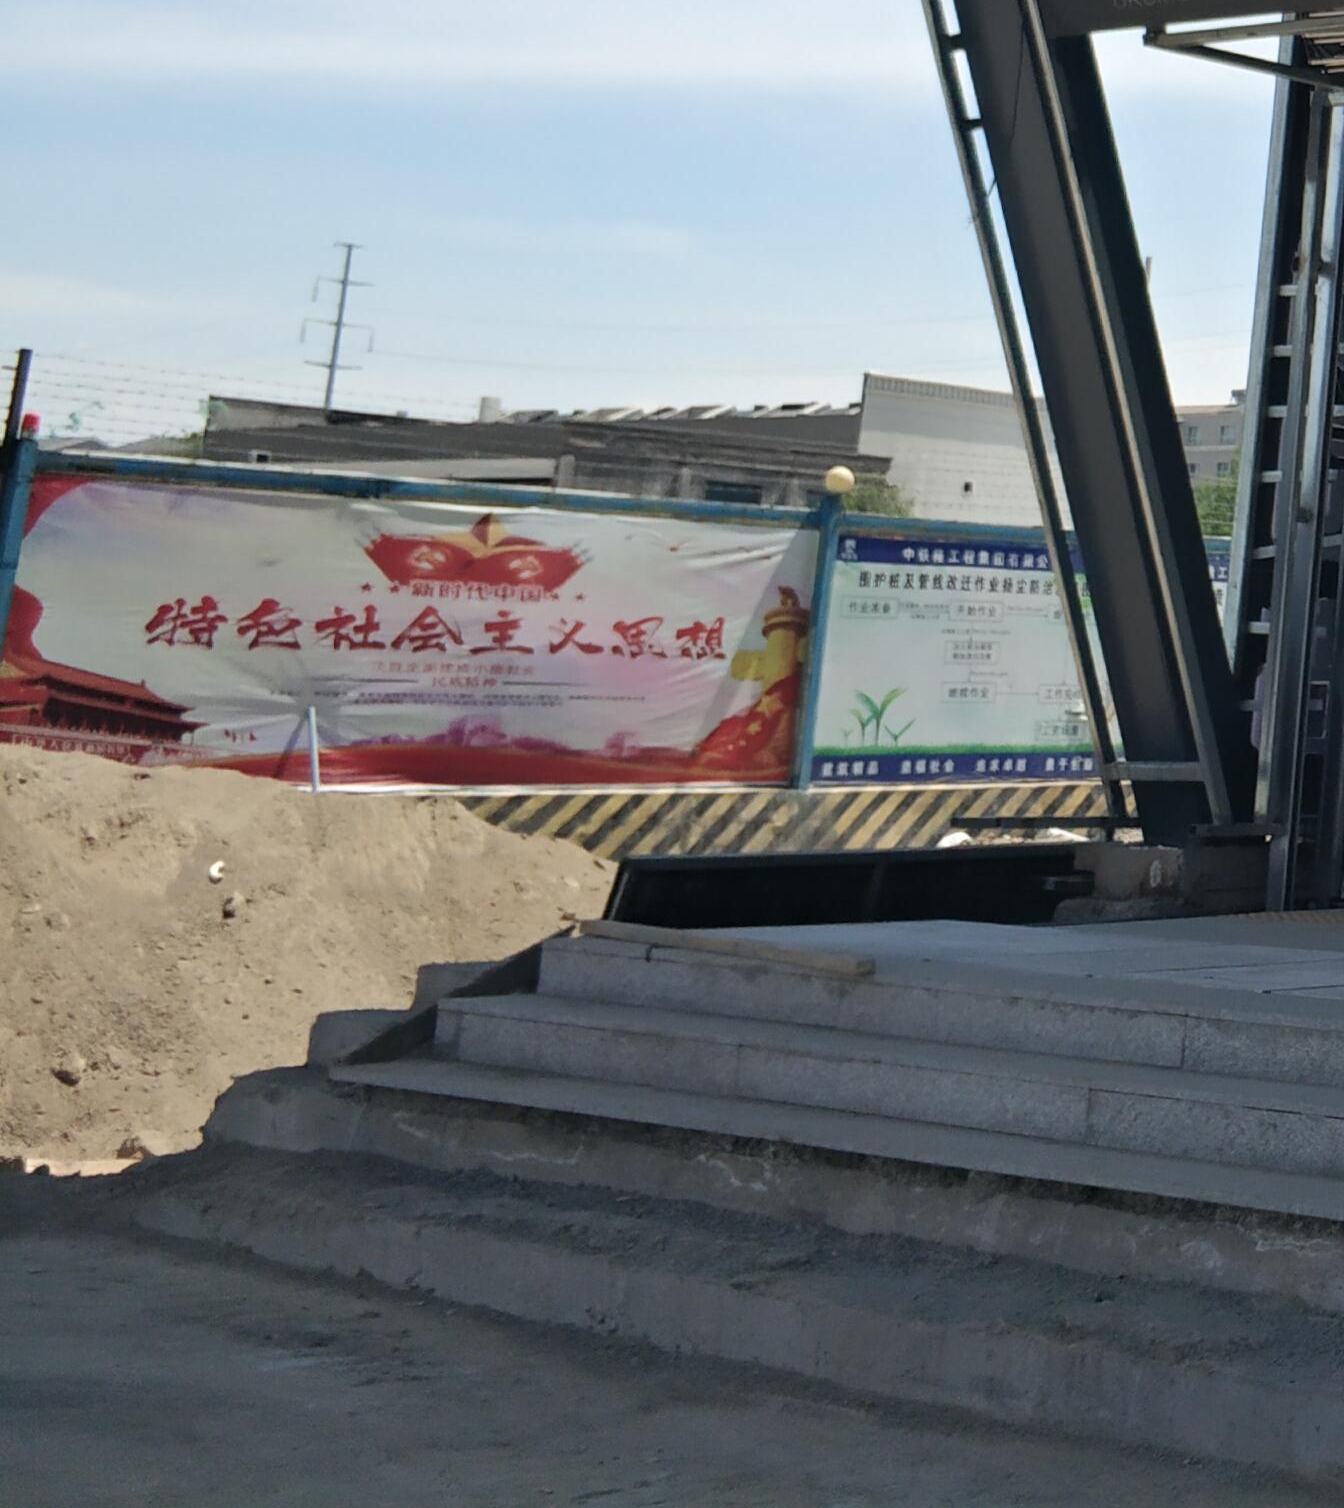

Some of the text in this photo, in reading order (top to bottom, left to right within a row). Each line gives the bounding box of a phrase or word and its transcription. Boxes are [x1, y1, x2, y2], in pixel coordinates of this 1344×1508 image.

[411, 581, 546, 603] 新时代中国
[144, 596, 728, 662] 特色社会主义思想
